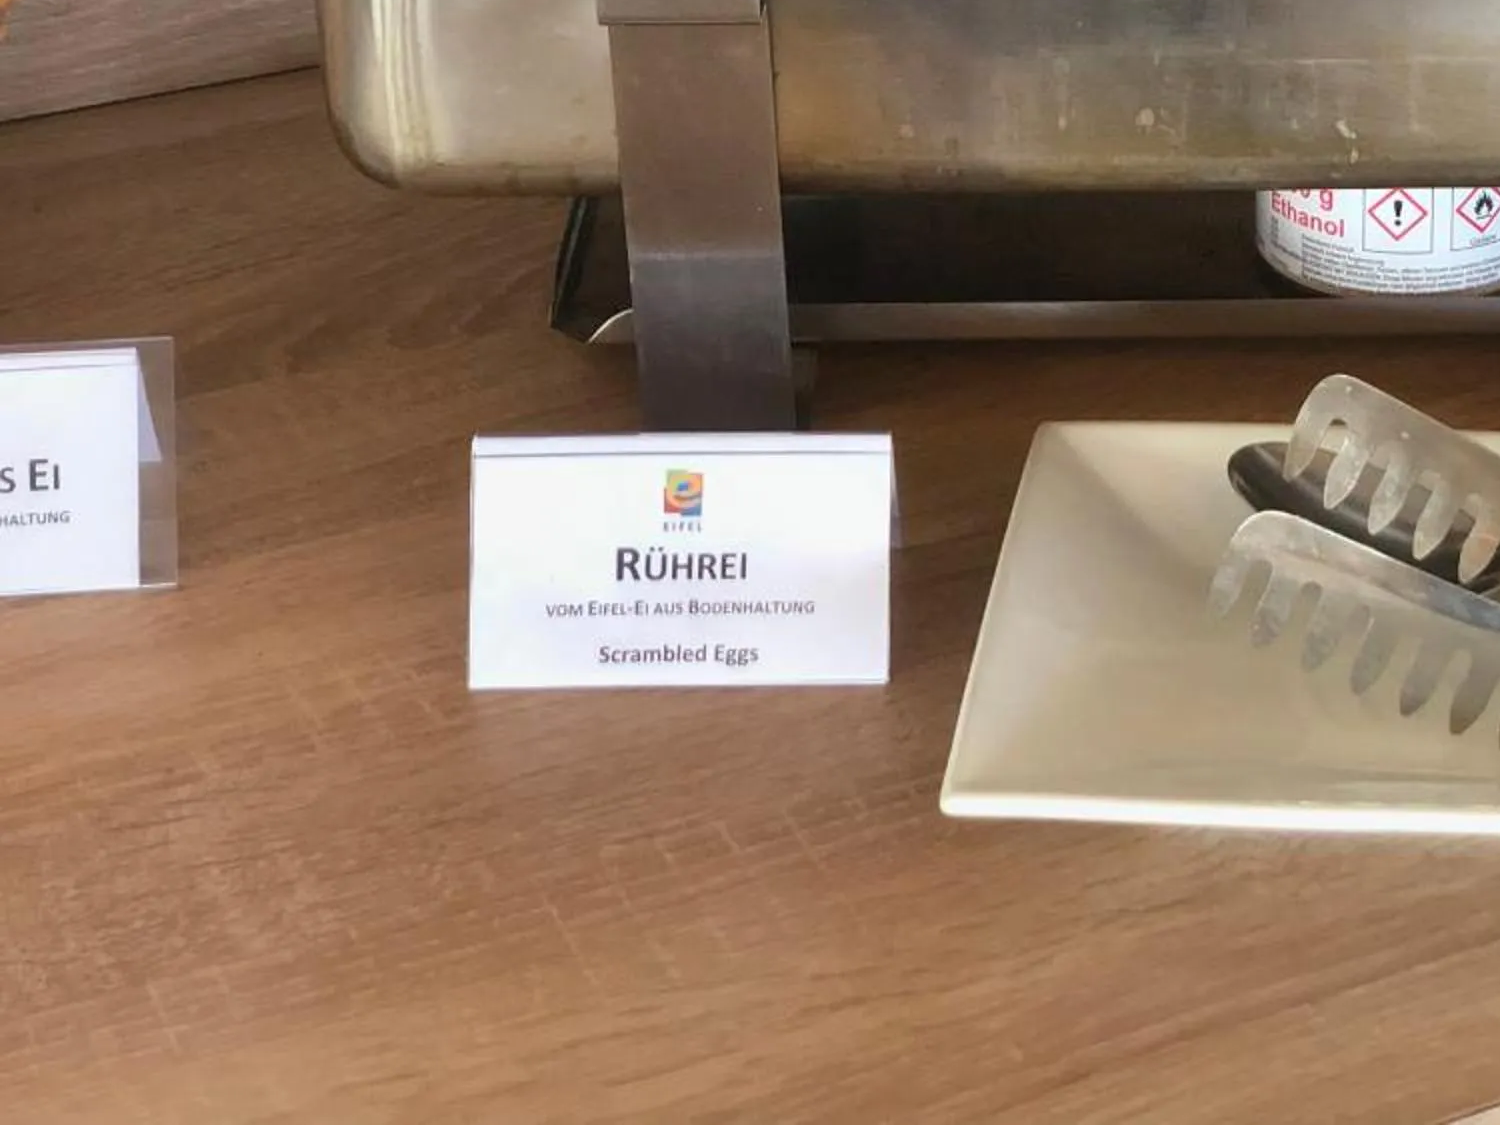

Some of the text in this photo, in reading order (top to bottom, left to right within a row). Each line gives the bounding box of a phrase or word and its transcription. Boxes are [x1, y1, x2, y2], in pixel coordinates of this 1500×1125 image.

[1271, 191, 1344, 237] Ethanol
[29, 459, 60, 491] EI
[662, 522, 703, 532] EIFEL
[615, 547, 747, 581] RÜHREI
[546, 599, 815, 618] VOM EIFEL-EI AUS BODENHALTUNG
[599, 644, 759, 667] Scrambled Eggs
